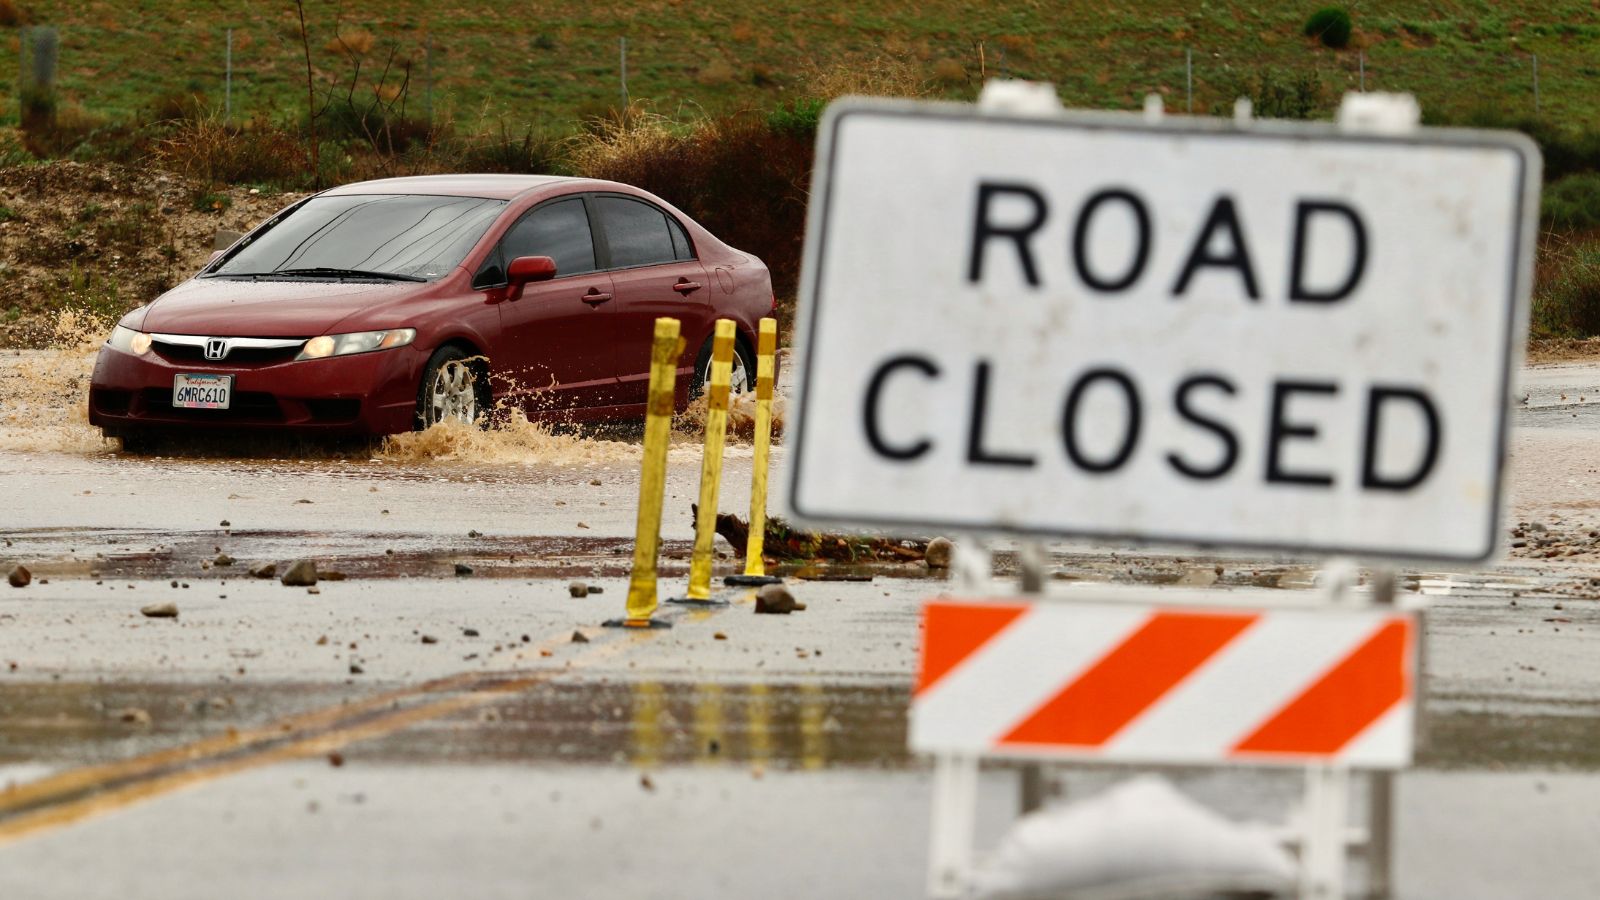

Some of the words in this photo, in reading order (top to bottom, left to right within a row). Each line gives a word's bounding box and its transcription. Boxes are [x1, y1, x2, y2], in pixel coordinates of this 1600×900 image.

[967, 181, 1369, 305] ROAD
[177, 387, 226, 403] 6MRC610
[186, 378, 220, 386] California
[862, 354, 1443, 494] CLOSED
